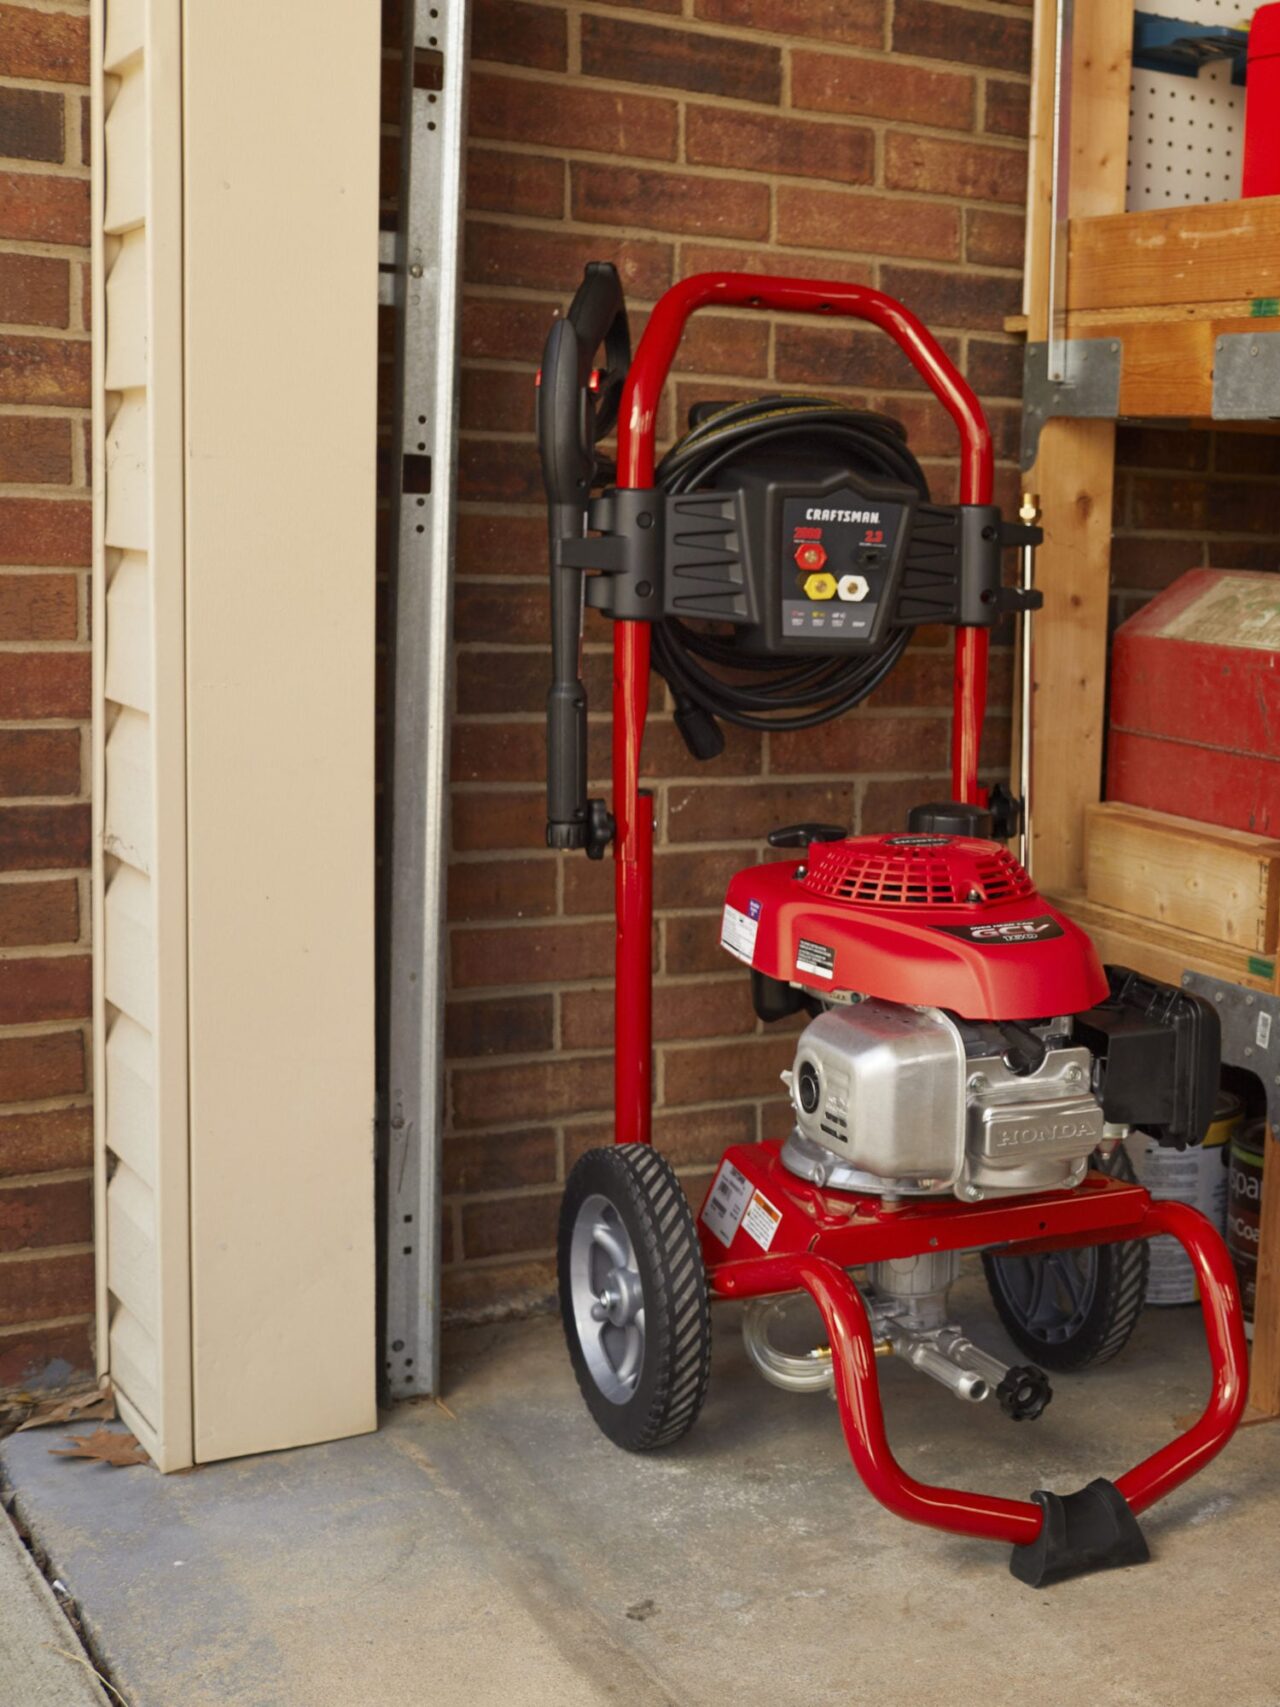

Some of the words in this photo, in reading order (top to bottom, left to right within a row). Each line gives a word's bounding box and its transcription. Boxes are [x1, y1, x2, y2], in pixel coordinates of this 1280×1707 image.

[806, 508, 880, 523] CRAFTSMAN
[971, 922, 1050, 939] GCV
[997, 1119, 1097, 1147] HONDA
[1229, 1168, 1263, 1200] spa
